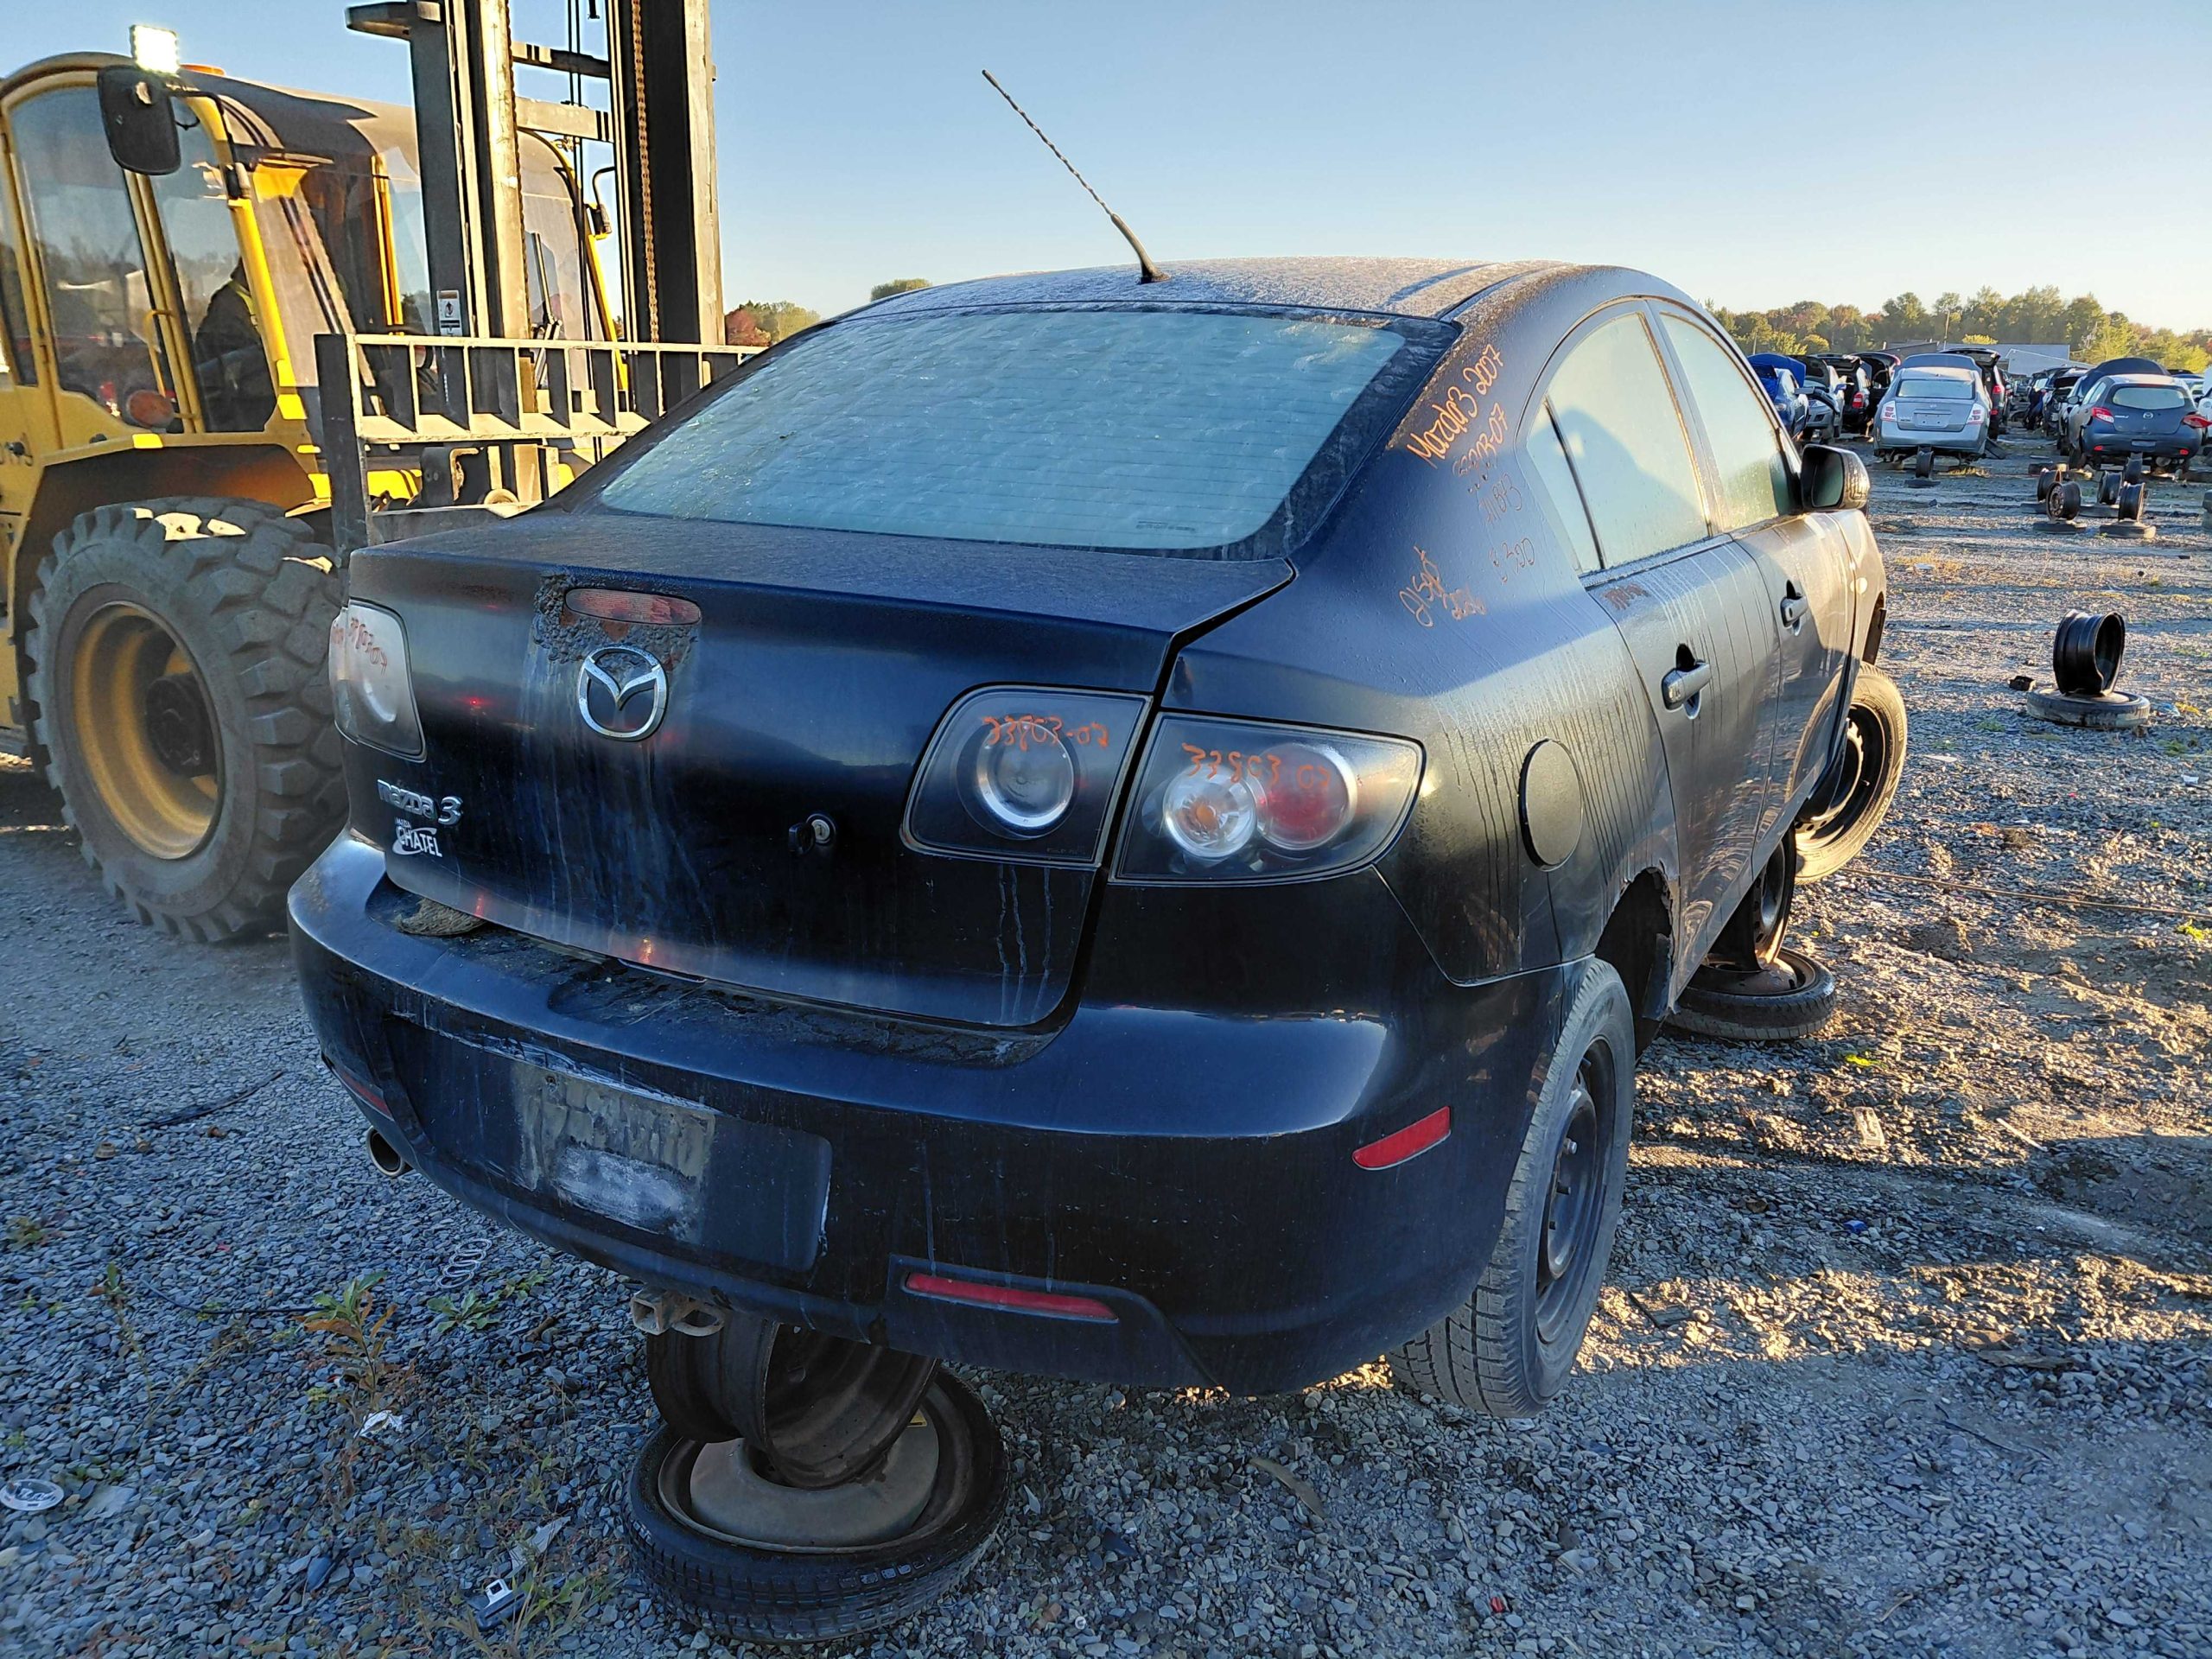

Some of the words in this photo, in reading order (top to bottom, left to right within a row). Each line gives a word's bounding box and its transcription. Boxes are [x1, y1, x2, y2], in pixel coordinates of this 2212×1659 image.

[1463, 343, 1504, 396] 2007
[437, 795, 464, 826] 3
[394, 824, 443, 858] CHATEL
